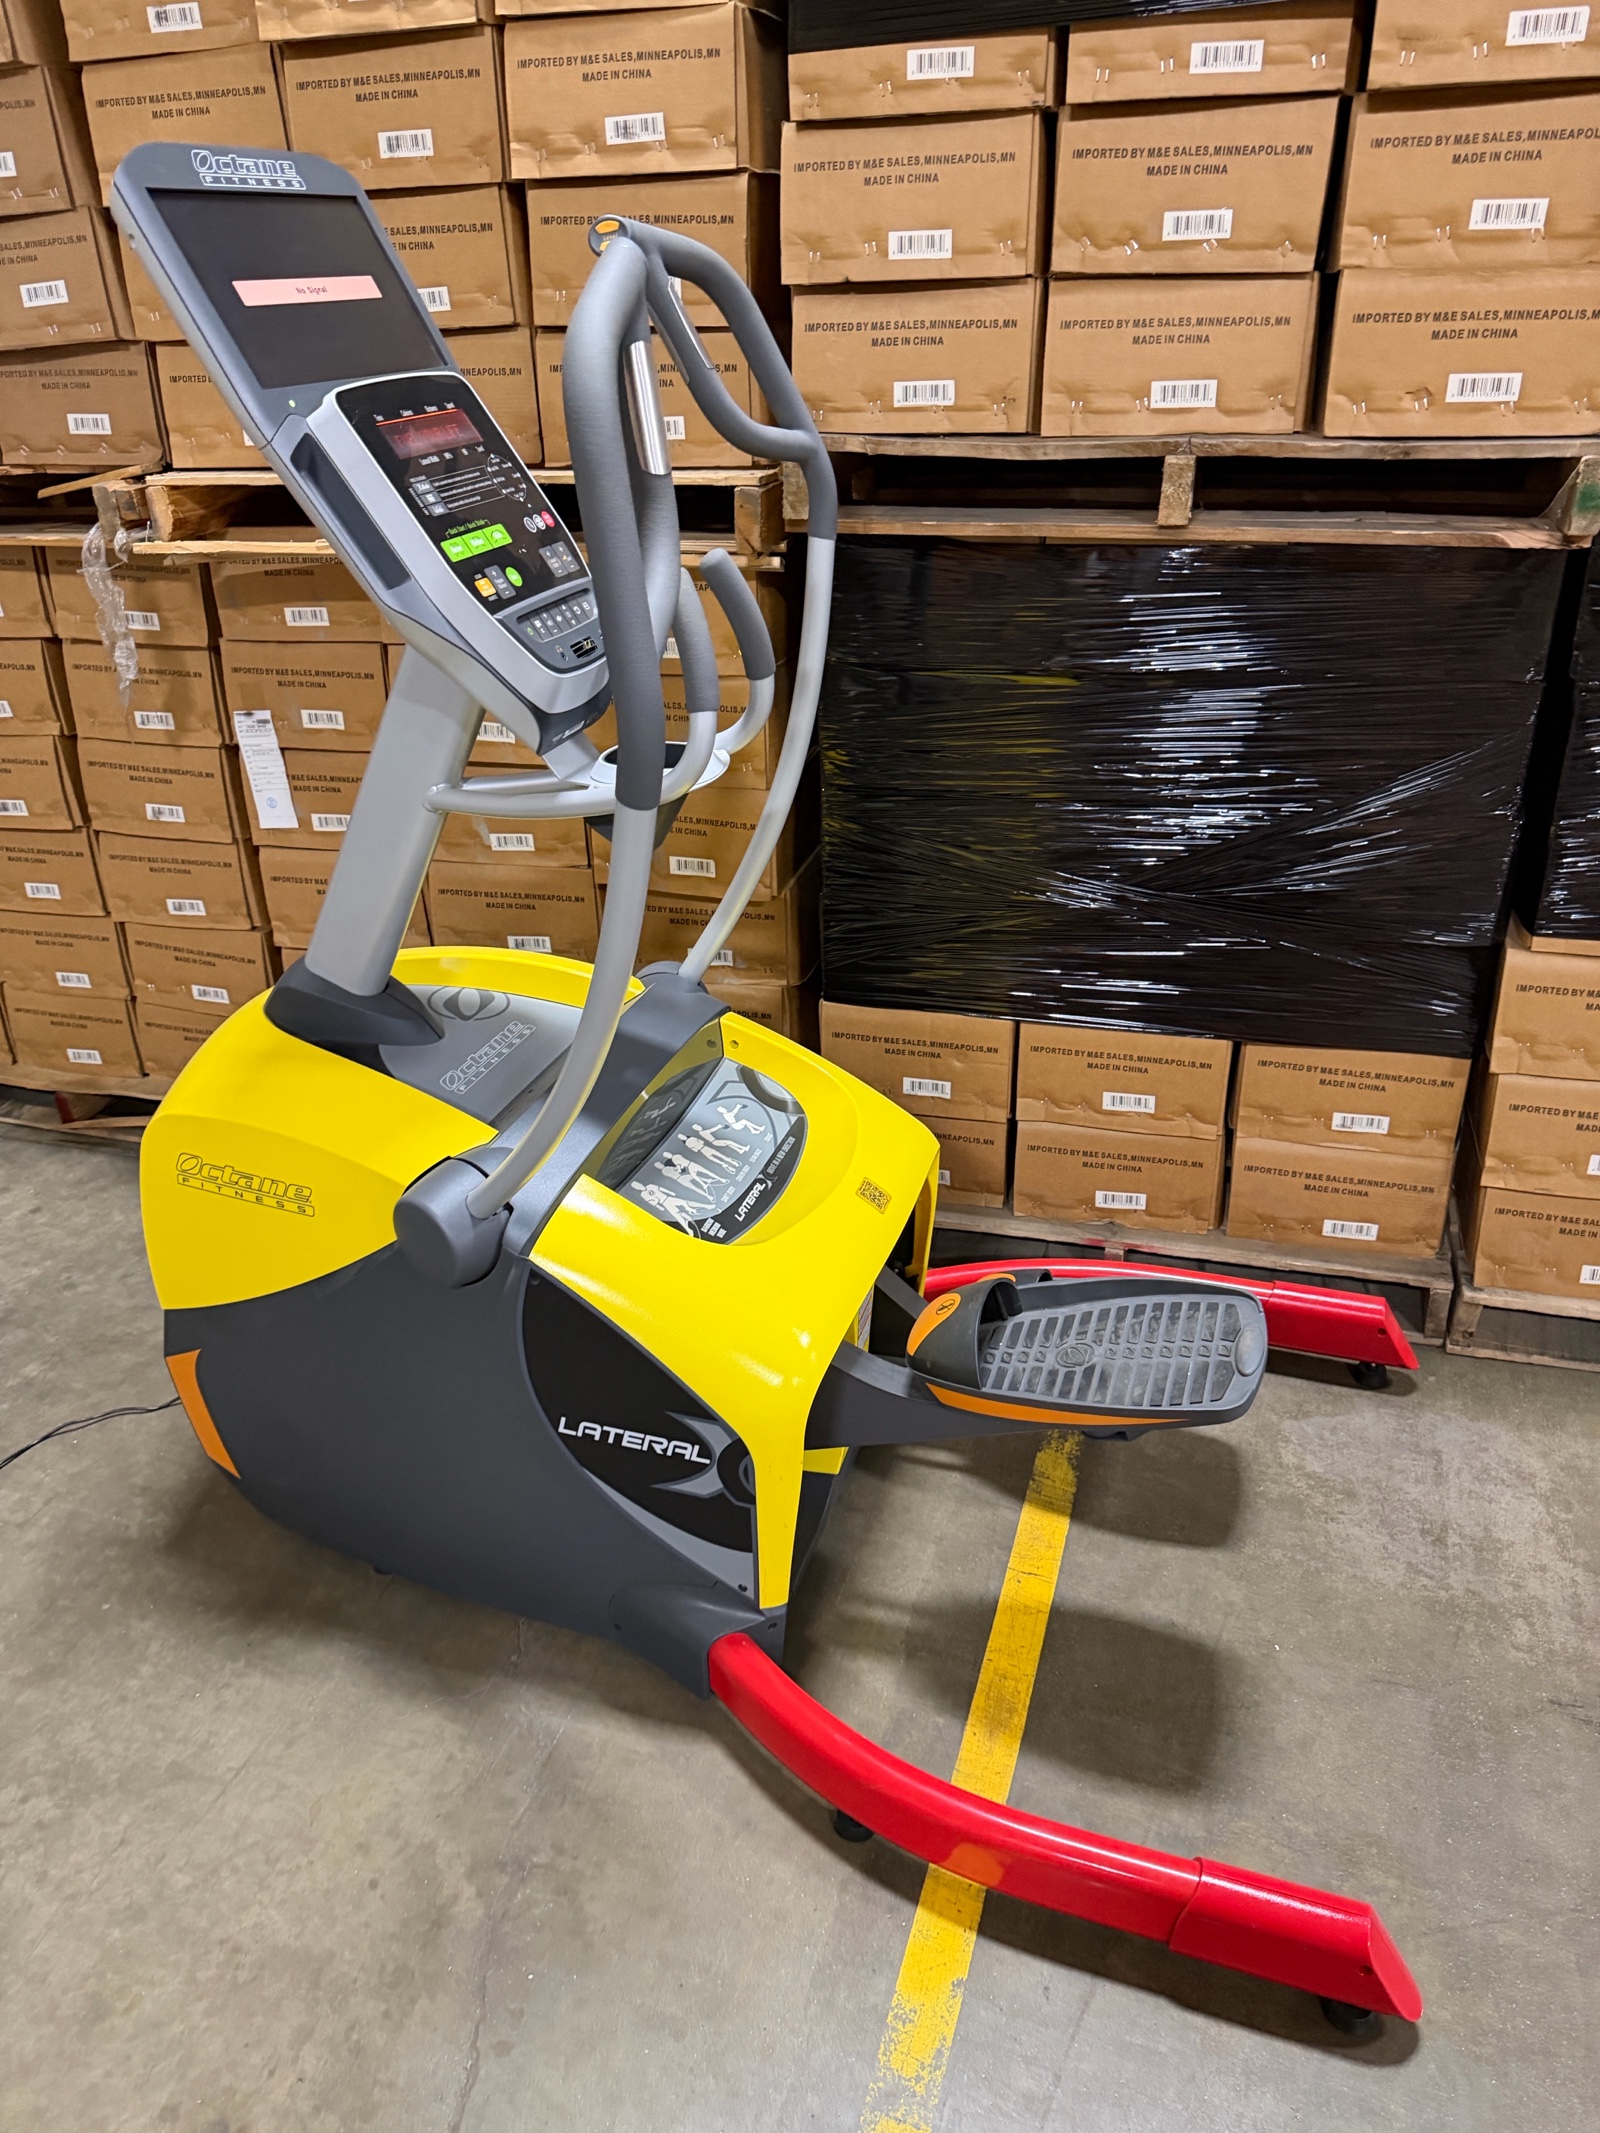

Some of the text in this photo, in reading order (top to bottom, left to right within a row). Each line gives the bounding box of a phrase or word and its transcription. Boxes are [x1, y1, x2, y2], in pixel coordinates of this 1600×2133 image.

[517, 56, 565, 68] IMPORTED
[566, 55, 579, 66] BY
[580, 54, 600, 64] M&E
[582, 68, 652, 81] MADE IN CHINA
[296, 78, 339, 90] IMPORTED
[340, 77, 352, 87] BY
[353, 75, 371, 86] M&E
[95, 96, 135, 108] IMPORTED
[136, 95, 148, 105] BY
[148, 94, 165, 104] M&E
[355, 88, 418, 102] MADE IN CHINA
[151, 106, 210, 119] MADE IN CHINA
[1371, 136, 1432, 148] IMPORTED
[1436, 134, 1452, 146] BY
[1454, 133, 1479, 145] M&E
[1072, 148, 1128, 158] IMPORTED
[1130, 147, 1145, 158] BY
[1147, 146, 1170, 158] M&E
[1452, 149, 1543, 164] MADE IN CHINA
[191, 149, 298, 177] Octane
[794, 160, 845, 172] IMPORTED
[847, 159, 861, 169] BY
[863, 158, 884, 169] M&E
[1146, 164, 1228, 175] MADE IN CHINA
[205, 176, 300, 188] FITNESS
[864, 172, 939, 186] MADE IN CHINA
[296, 285, 328, 295] No Signal
[1060, 319, 1114, 329] IMPORTED
[1116, 319, 1130, 328] BY
[1132, 318, 1154, 328] M&E
[1353, 312, 1412, 323] IMPORTED
[1415, 311, 1431, 322] BY
[1433, 311, 1458, 322] M&E
[804, 322, 854, 332] IMPORTED
[856, 321, 869, 331] BY
[870, 321, 891, 330] M&E
[871, 336, 944, 346] MADE IN CHINA
[1132, 334, 1210, 344] MADE IN CHINA
[1431, 328, 1518, 340] MADE IN CHINA
[231, 666, 265, 674] IMPORTED
[275, 668, 290, 676] M&E
[437, 888, 472, 896] IMPORTED
[1516, 984, 1585, 997] IMPORTED BY
[831, 1031, 870, 1041] IMPORTED
[872, 1035, 882, 1043] BY
[883, 1036, 900, 1044] M&E
[440, 1021, 524, 1090] Octane
[884, 1047, 906, 1055] MADE
[917, 1050, 941, 1058] CHINA
[1030, 1045, 1072, 1055] IMPORTED
[1074, 1049, 1086, 1057] BY
[1086, 1050, 1104, 1059] M&E
[459, 1029, 531, 1091] FITNESS
[1257, 1059, 1304, 1071] IMPORTED
[1306, 1064, 1318, 1073] BY
[1319, 1066, 1339, 1075] M&E
[1087, 1062, 1110, 1070] MADE
[1122, 1065, 1149, 1074] CHINA
[1319, 1078, 1344, 1087] MADE
[1357, 1082, 1386, 1092] CHINA
[1509, 1104, 1560, 1115] IMPORTED
[1578, 1111, 1599, 1119] M&E
[1027, 1144, 1068, 1154] IMPORTED
[1082, 1150, 1099, 1158] M&E
[1082, 1161, 1105, 1169] MADE
[1116, 1164, 1142, 1172] CHINA
[1244, 1164, 1289, 1176] IMPORTED
[1290, 1170, 1303, 1178] BY
[1304, 1172, 1323, 1181] M&E
[176, 1152, 312, 1203] Octane
[182, 1177, 306, 1214] FITNESS
[1303, 1183, 1328, 1192] MADE
[1341, 1188, 1369, 1197] CHINA
[734, 1182, 766, 1221] LATERAL
[1494, 1208, 1544, 1220] IMPORTED
[1560, 1216, 1581, 1224] M&E
[1559, 1228, 1586, 1236] MADE
[558, 1416, 710, 1465] LATERAL
